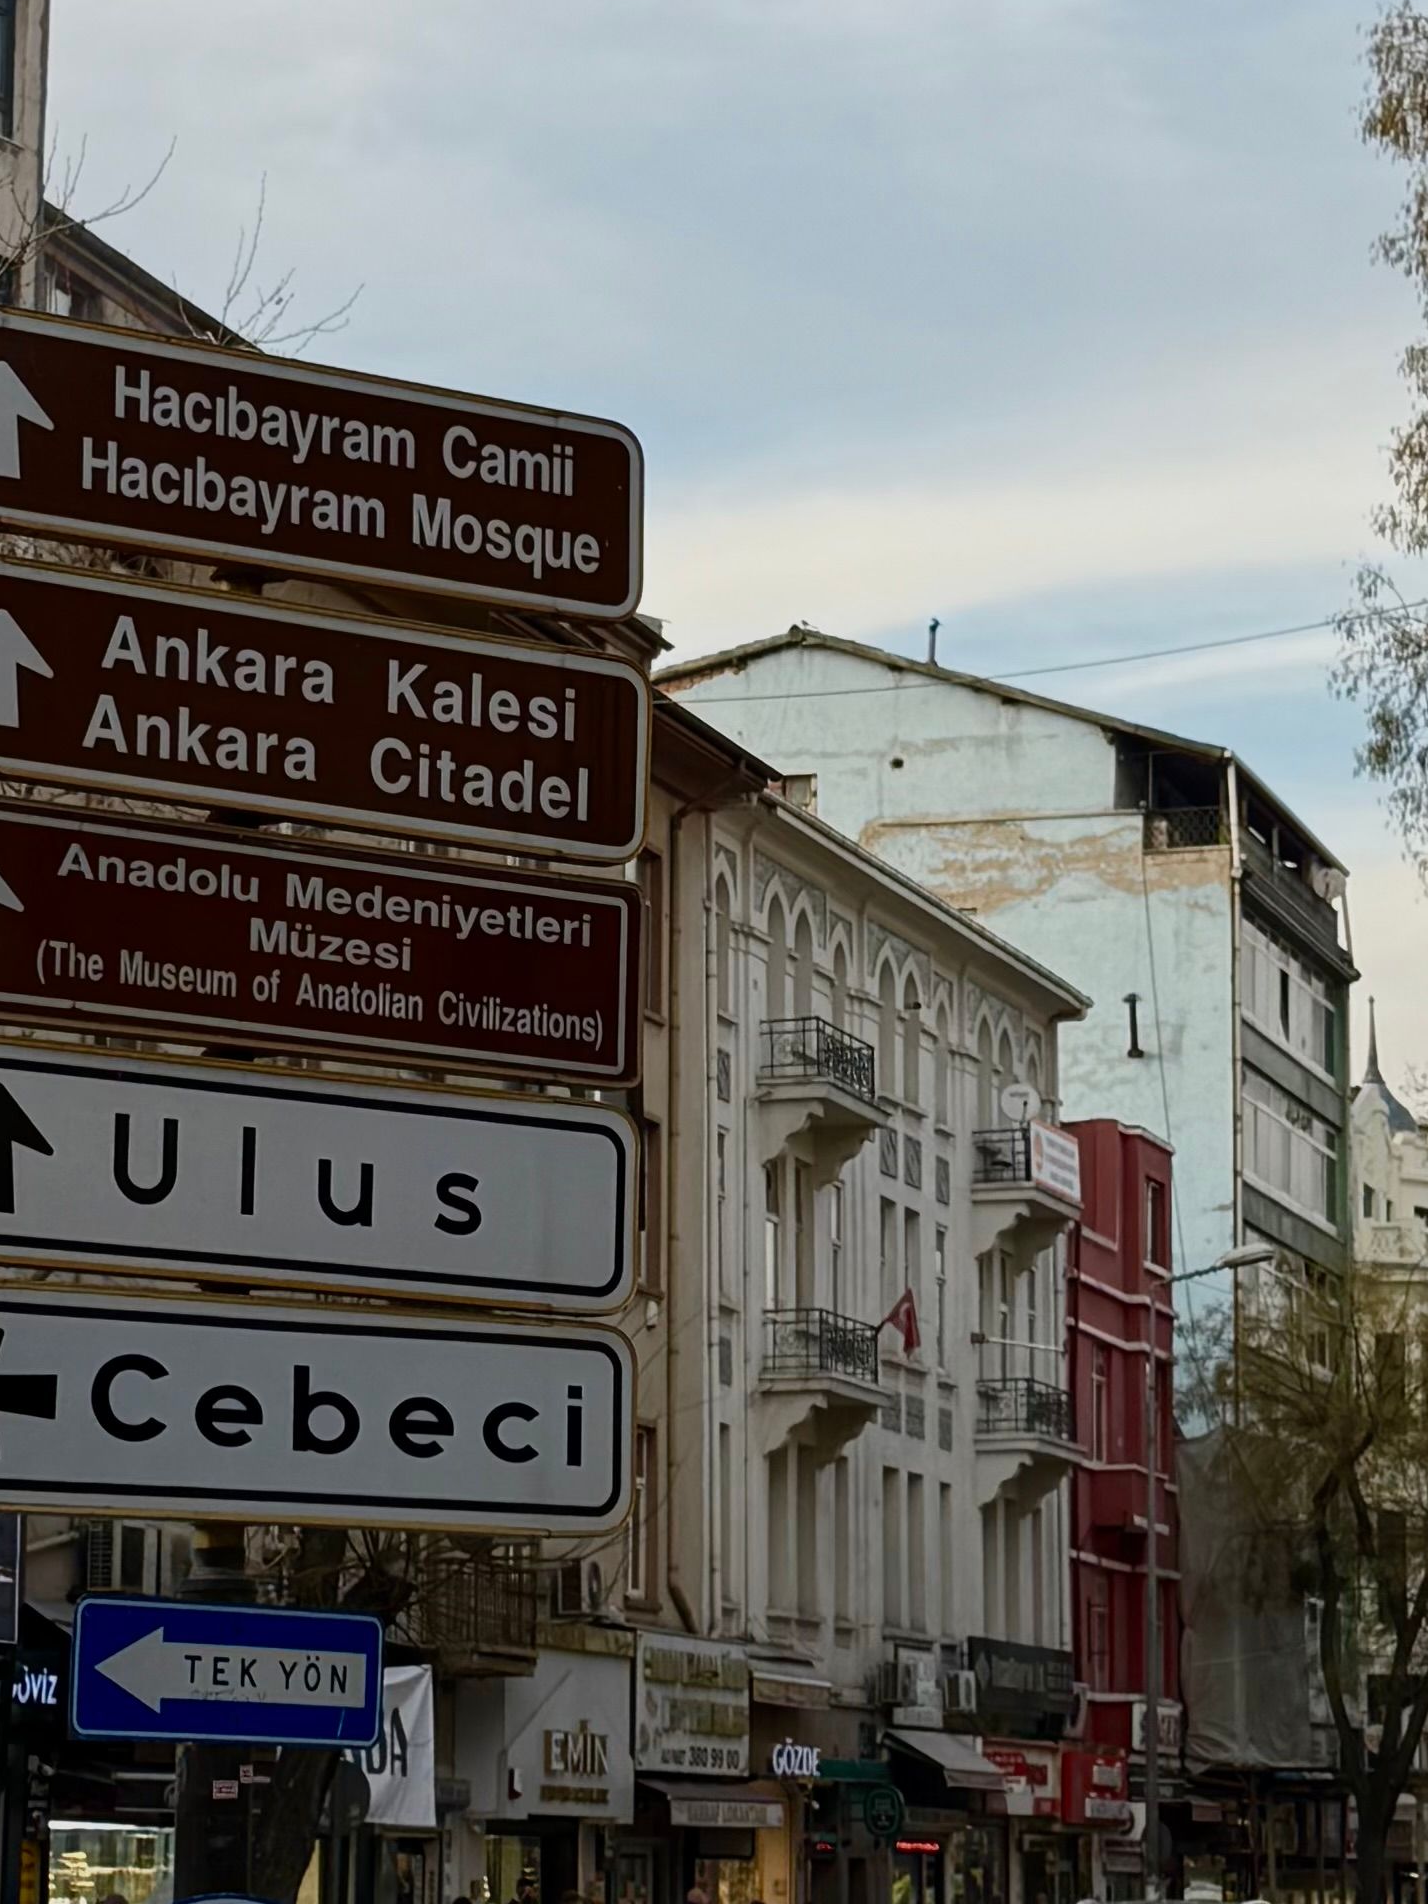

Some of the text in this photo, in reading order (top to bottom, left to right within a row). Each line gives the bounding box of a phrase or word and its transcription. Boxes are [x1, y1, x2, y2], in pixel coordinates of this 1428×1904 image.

[113, 365, 575, 497] Hacıbayram Camii
[82, 437, 601, 578] Hacıbayram Mosque
[102, 615, 577, 743] Ankara Kalesi
[83, 694, 589, 821] Ankara Citadel
[58, 843, 593, 948] Anadolu Medeniyetleri
[249, 917, 411, 972] Müzesi
[36, 938, 604, 1051] (The Museum of Anatolian Civilizations)
[113, 1113, 483, 1237] Ulus
[91, 1353, 585, 1467] Cebeci
[185, 1653, 347, 1694] TEK YÖN
